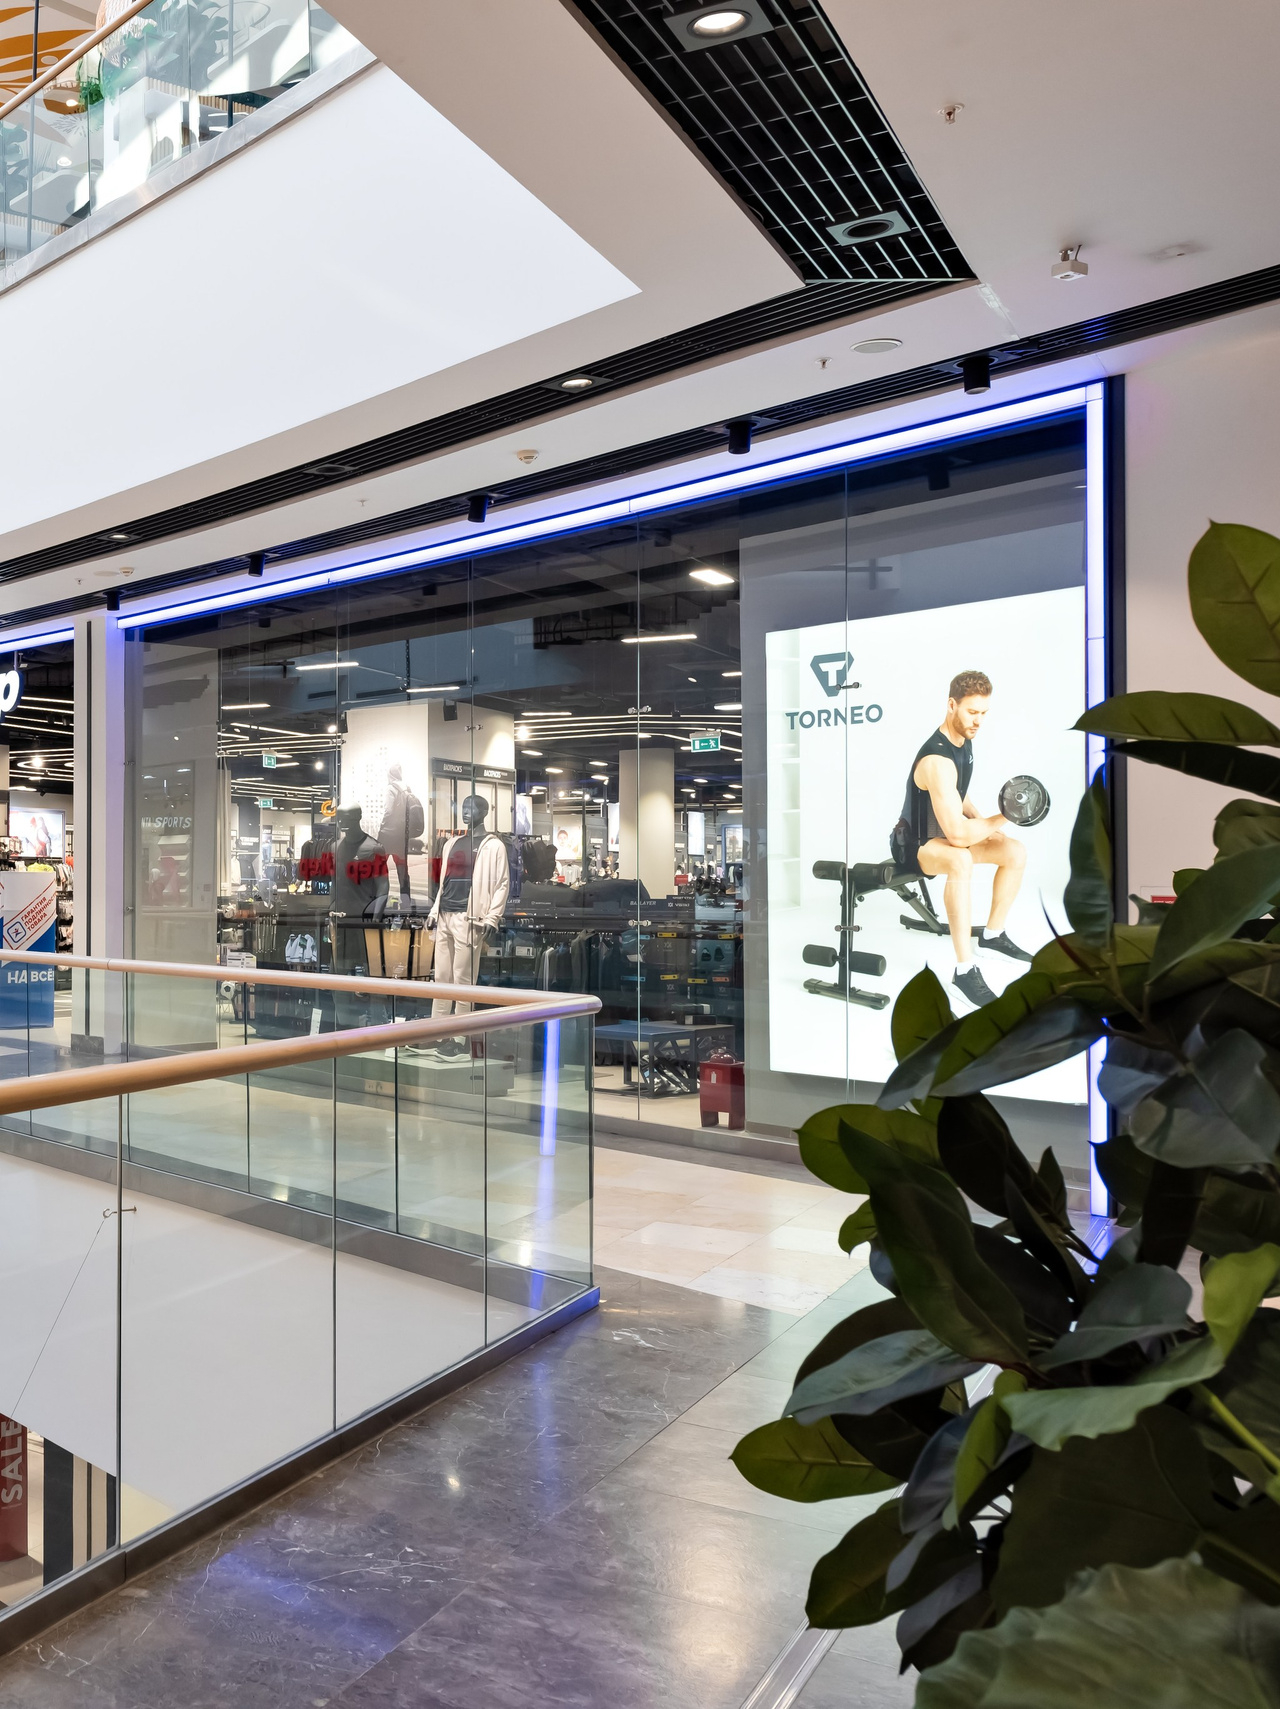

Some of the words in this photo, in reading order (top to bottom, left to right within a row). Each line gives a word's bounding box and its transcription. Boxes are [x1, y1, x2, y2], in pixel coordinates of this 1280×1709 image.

[784, 703, 883, 731] TORNEO
[20, 896, 47, 922] ГАРАНТИЯ
[27, 912, 48, 932] ТОВАРА
[7, 969, 28, 984] НА
[0, 1420, 23, 1504] SALE
